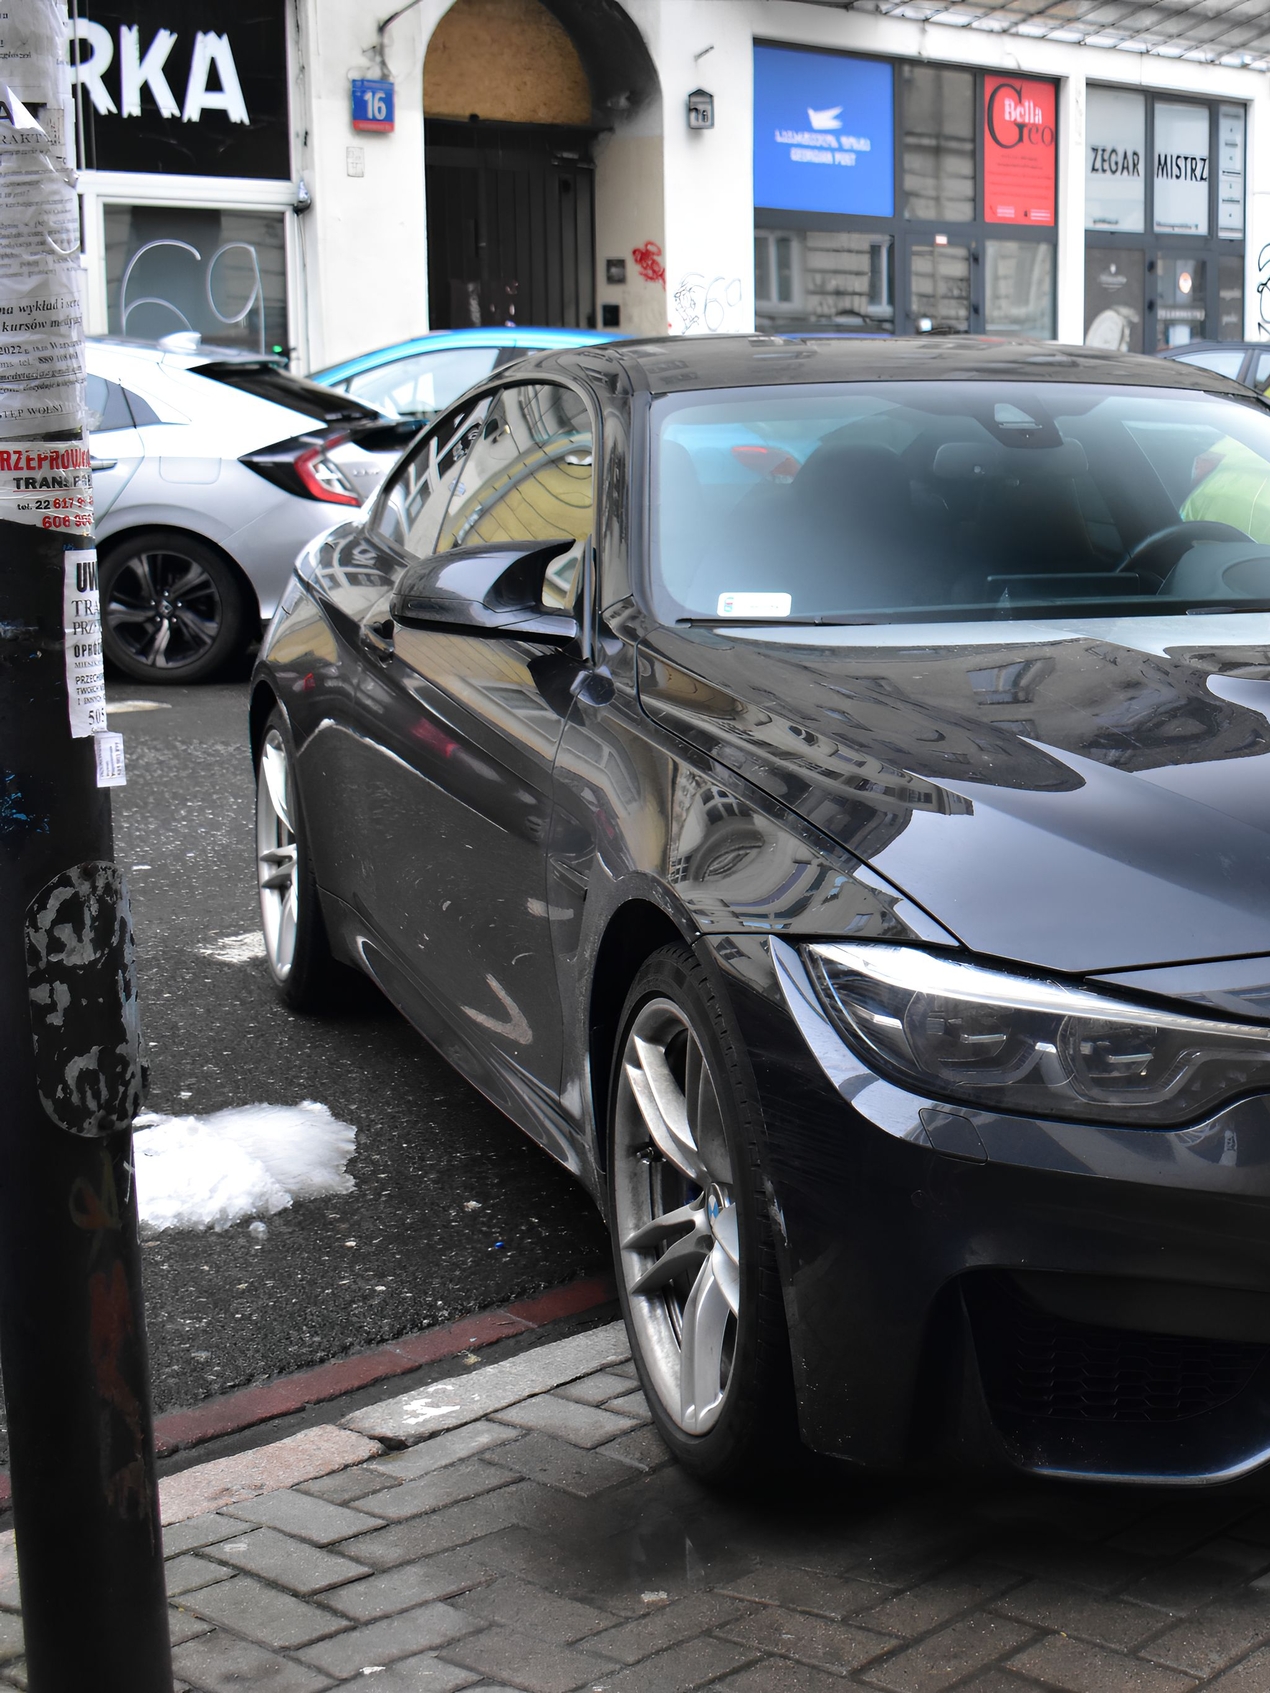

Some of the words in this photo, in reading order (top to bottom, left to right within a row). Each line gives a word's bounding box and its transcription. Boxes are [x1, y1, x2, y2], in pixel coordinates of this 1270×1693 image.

[363, 90, 387, 120] 16
[1004, 98, 1042, 124] Bella
[1091, 147, 1140, 177] ZEGAR
[1156, 153, 1208, 182] MISTRZ
[18, 299, 58, 315] wykład
[2, 319, 47, 332] kursów
[35, 500, 51, 510] 22
[53, 498, 74, 509] 617
